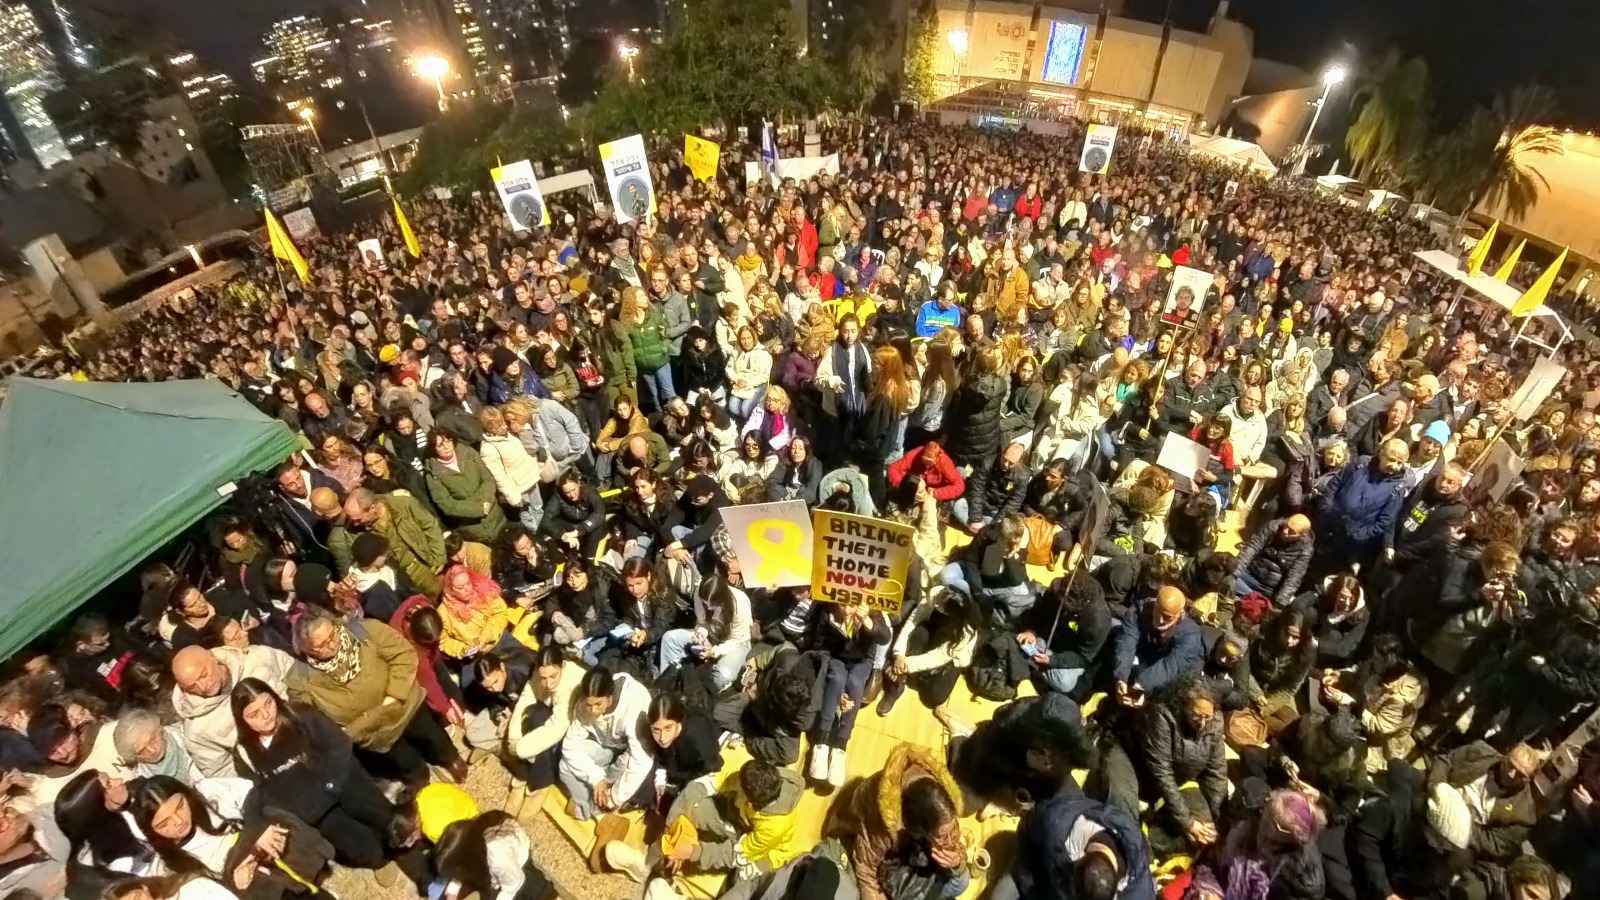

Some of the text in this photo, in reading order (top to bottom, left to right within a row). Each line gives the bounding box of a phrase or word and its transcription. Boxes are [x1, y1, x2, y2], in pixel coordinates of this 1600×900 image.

[830, 518, 910, 547] BRING
[822, 536, 887, 559] THEM
[827, 554, 889, 578] HOME
[826, 571, 877, 590] NOW
[821, 586, 899, 611] 493 DAYS
